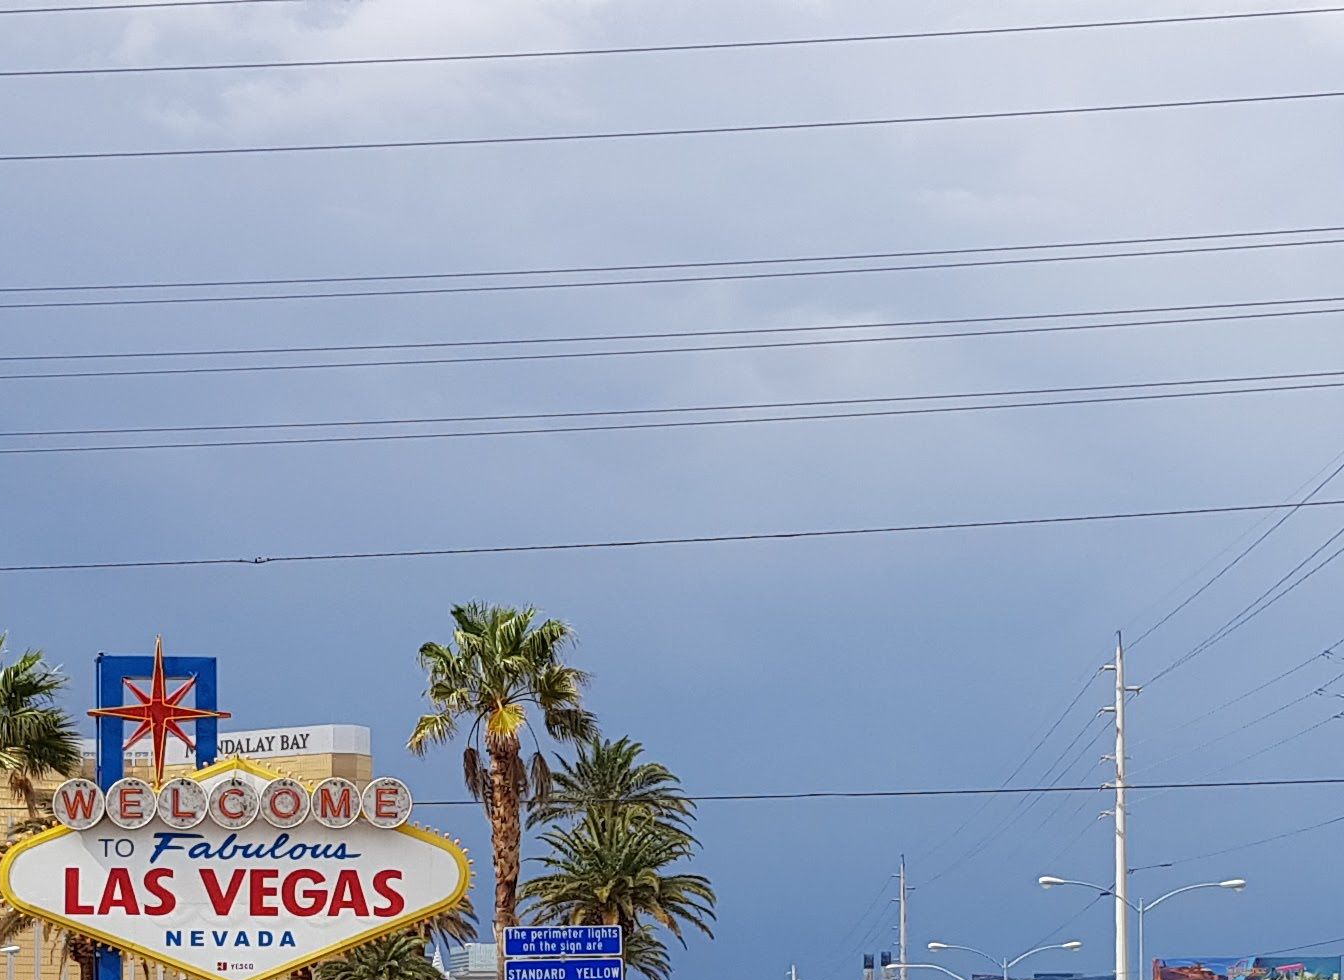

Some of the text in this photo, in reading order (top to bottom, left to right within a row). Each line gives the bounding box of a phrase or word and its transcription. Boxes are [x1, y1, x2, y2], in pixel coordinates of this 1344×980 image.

[185, 733, 310, 758] MNDALAY BAY
[59, 786, 401, 819] WELCOME
[98, 832, 362, 863] TO Fabulous
[64, 867, 405, 917] LAS VEGAS
[165, 930, 297, 947] NEVADA
[508, 927, 619, 942] The perimeter lights
[523, 941, 603, 954] on the sign are
[508, 967, 619, 980] STANDARD YELLOW
